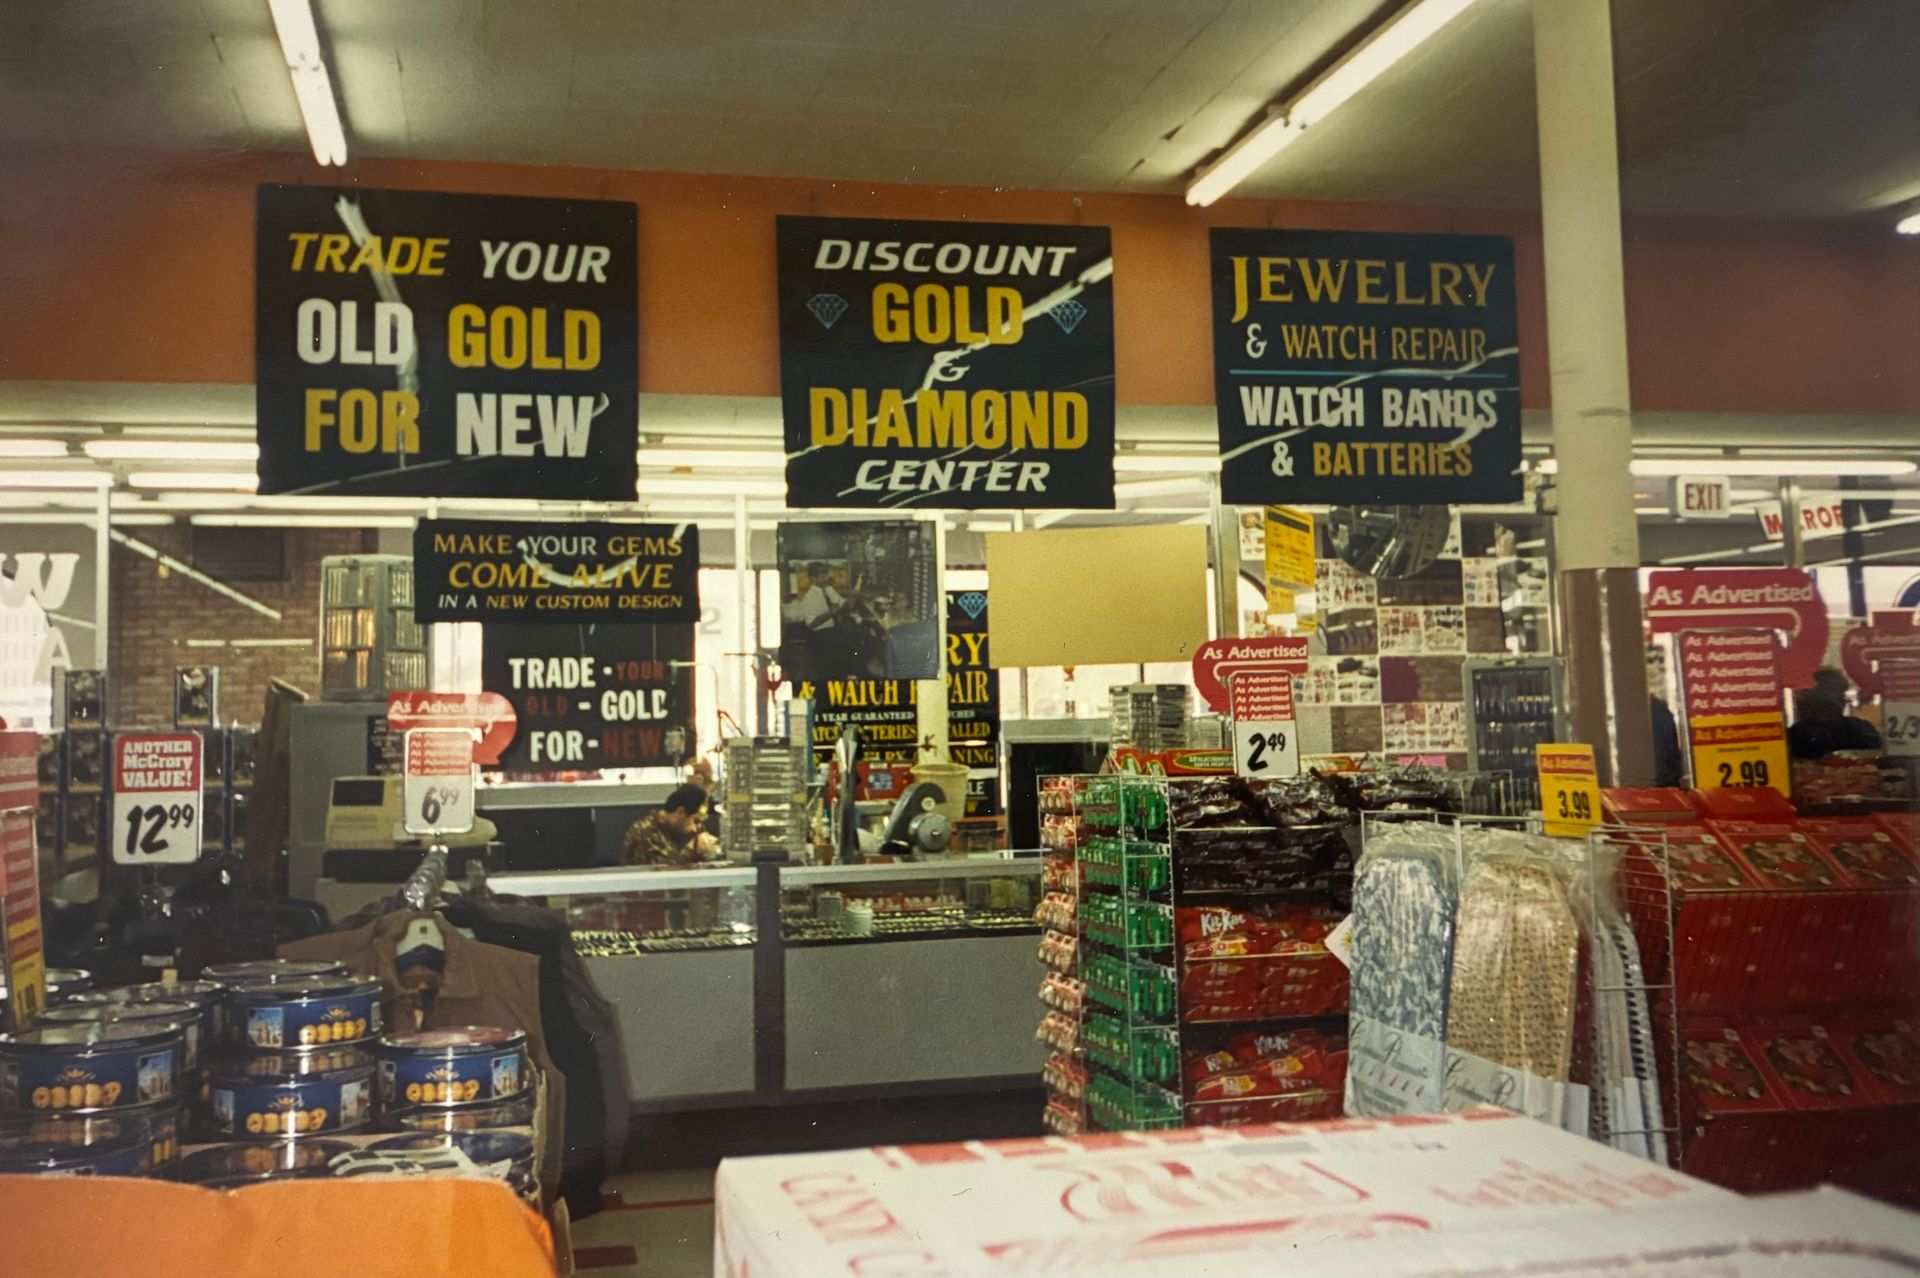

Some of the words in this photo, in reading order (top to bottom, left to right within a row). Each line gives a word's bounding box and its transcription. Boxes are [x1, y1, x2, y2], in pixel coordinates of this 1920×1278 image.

[288, 232, 450, 276] TRADE
[480, 240, 611, 283] YOUR
[814, 239, 1077, 277] DISCOUNT
[1229, 256, 1496, 323] JEWELRY
[872, 282, 1024, 346] GOLD
[297, 298, 414, 366] OLD
[448, 303, 601, 371] GOLD
[1246, 323, 1267, 358] &
[1281, 324, 1377, 360] WATCH
[1391, 327, 1486, 362] REPAIR
[933, 351, 970, 382] &
[305, 388, 420, 455] FOR
[456, 392, 595, 458] NEW
[809, 387, 1089, 450] DIAMOND
[1239, 386, 1365, 428] WATCH
[1382, 387, 1498, 429] BANDS
[1271, 441, 1294, 477] &
[1313, 442, 1473, 477] BATTERIES
[855, 460, 1050, 492] CENTER
[1684, 483, 1723, 511] EXIT
[434, 534, 512, 555] MAKE
[528, 536, 597, 556] YOUR
[607, 536, 683, 556] GEMS
[449, 562, 552, 589] COME
[570, 563, 673, 589] ALIVE
[438, 594, 459, 609] IN
[465, 594, 478, 609] A
[486, 594, 528, 609] NEW
[535, 595, 610, 609] CUSTOM
[618, 595, 683, 609] DESIGN
[1650, 586, 1683, 606] As
[1690, 584, 1813, 604] Advertised
[1203, 647, 1223, 660] As
[1228, 645, 1307, 659] Advertised
[508, 657, 596, 689] TRADE
[601, 689, 668, 722] GOLD
[123, 741, 192, 754] ANOTHER
[530, 730, 584, 762] FOR
[123, 754, 193, 771] McCrory
[1718, 760, 1769, 787] 2.99
[122, 770, 192, 788] VALUE!
[1557, 790, 1591, 819] 3.99
